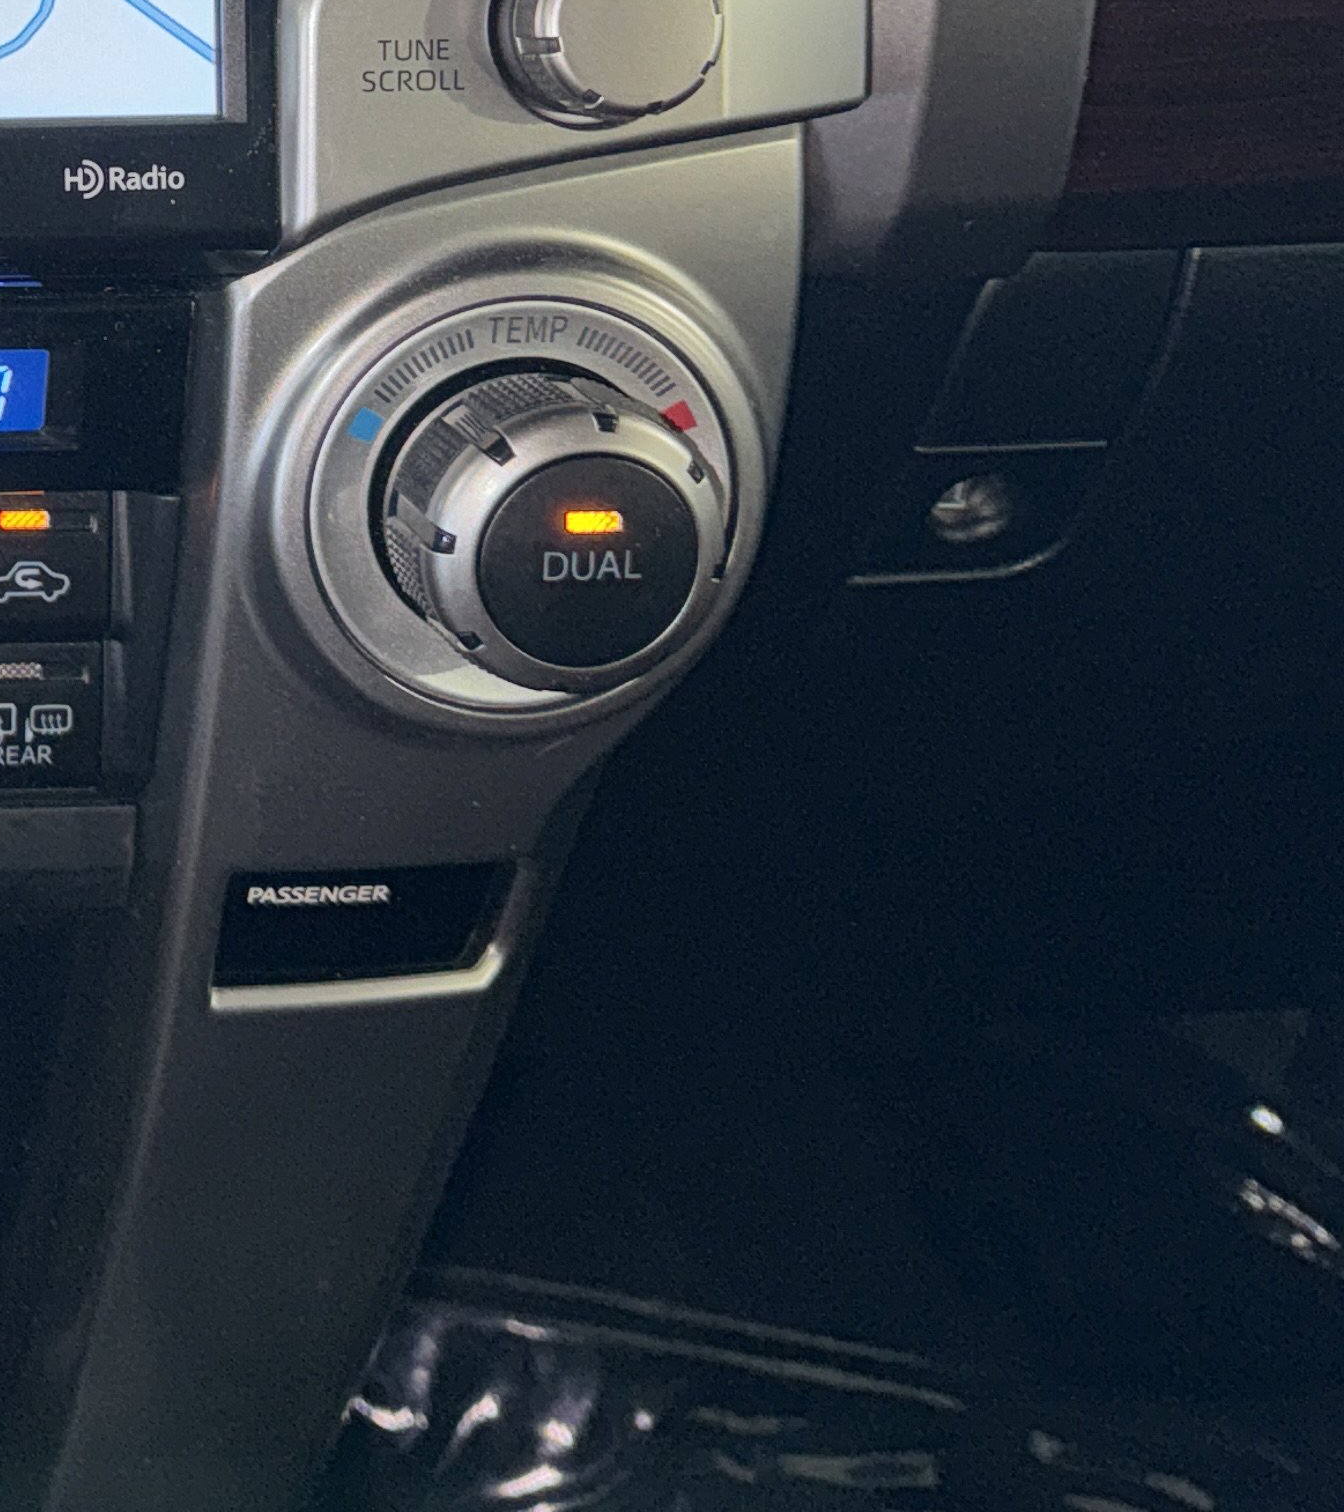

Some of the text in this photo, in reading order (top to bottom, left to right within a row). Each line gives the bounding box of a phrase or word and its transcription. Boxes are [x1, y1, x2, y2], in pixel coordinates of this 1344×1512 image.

[377, 38, 451, 62] TUNE
[361, 68, 466, 94] SCROLL
[108, 164, 186, 191] Radio
[488, 314, 570, 345] TEMP
[541, 549, 643, 583] DUAL
[246, 884, 392, 907] PASSENGER
